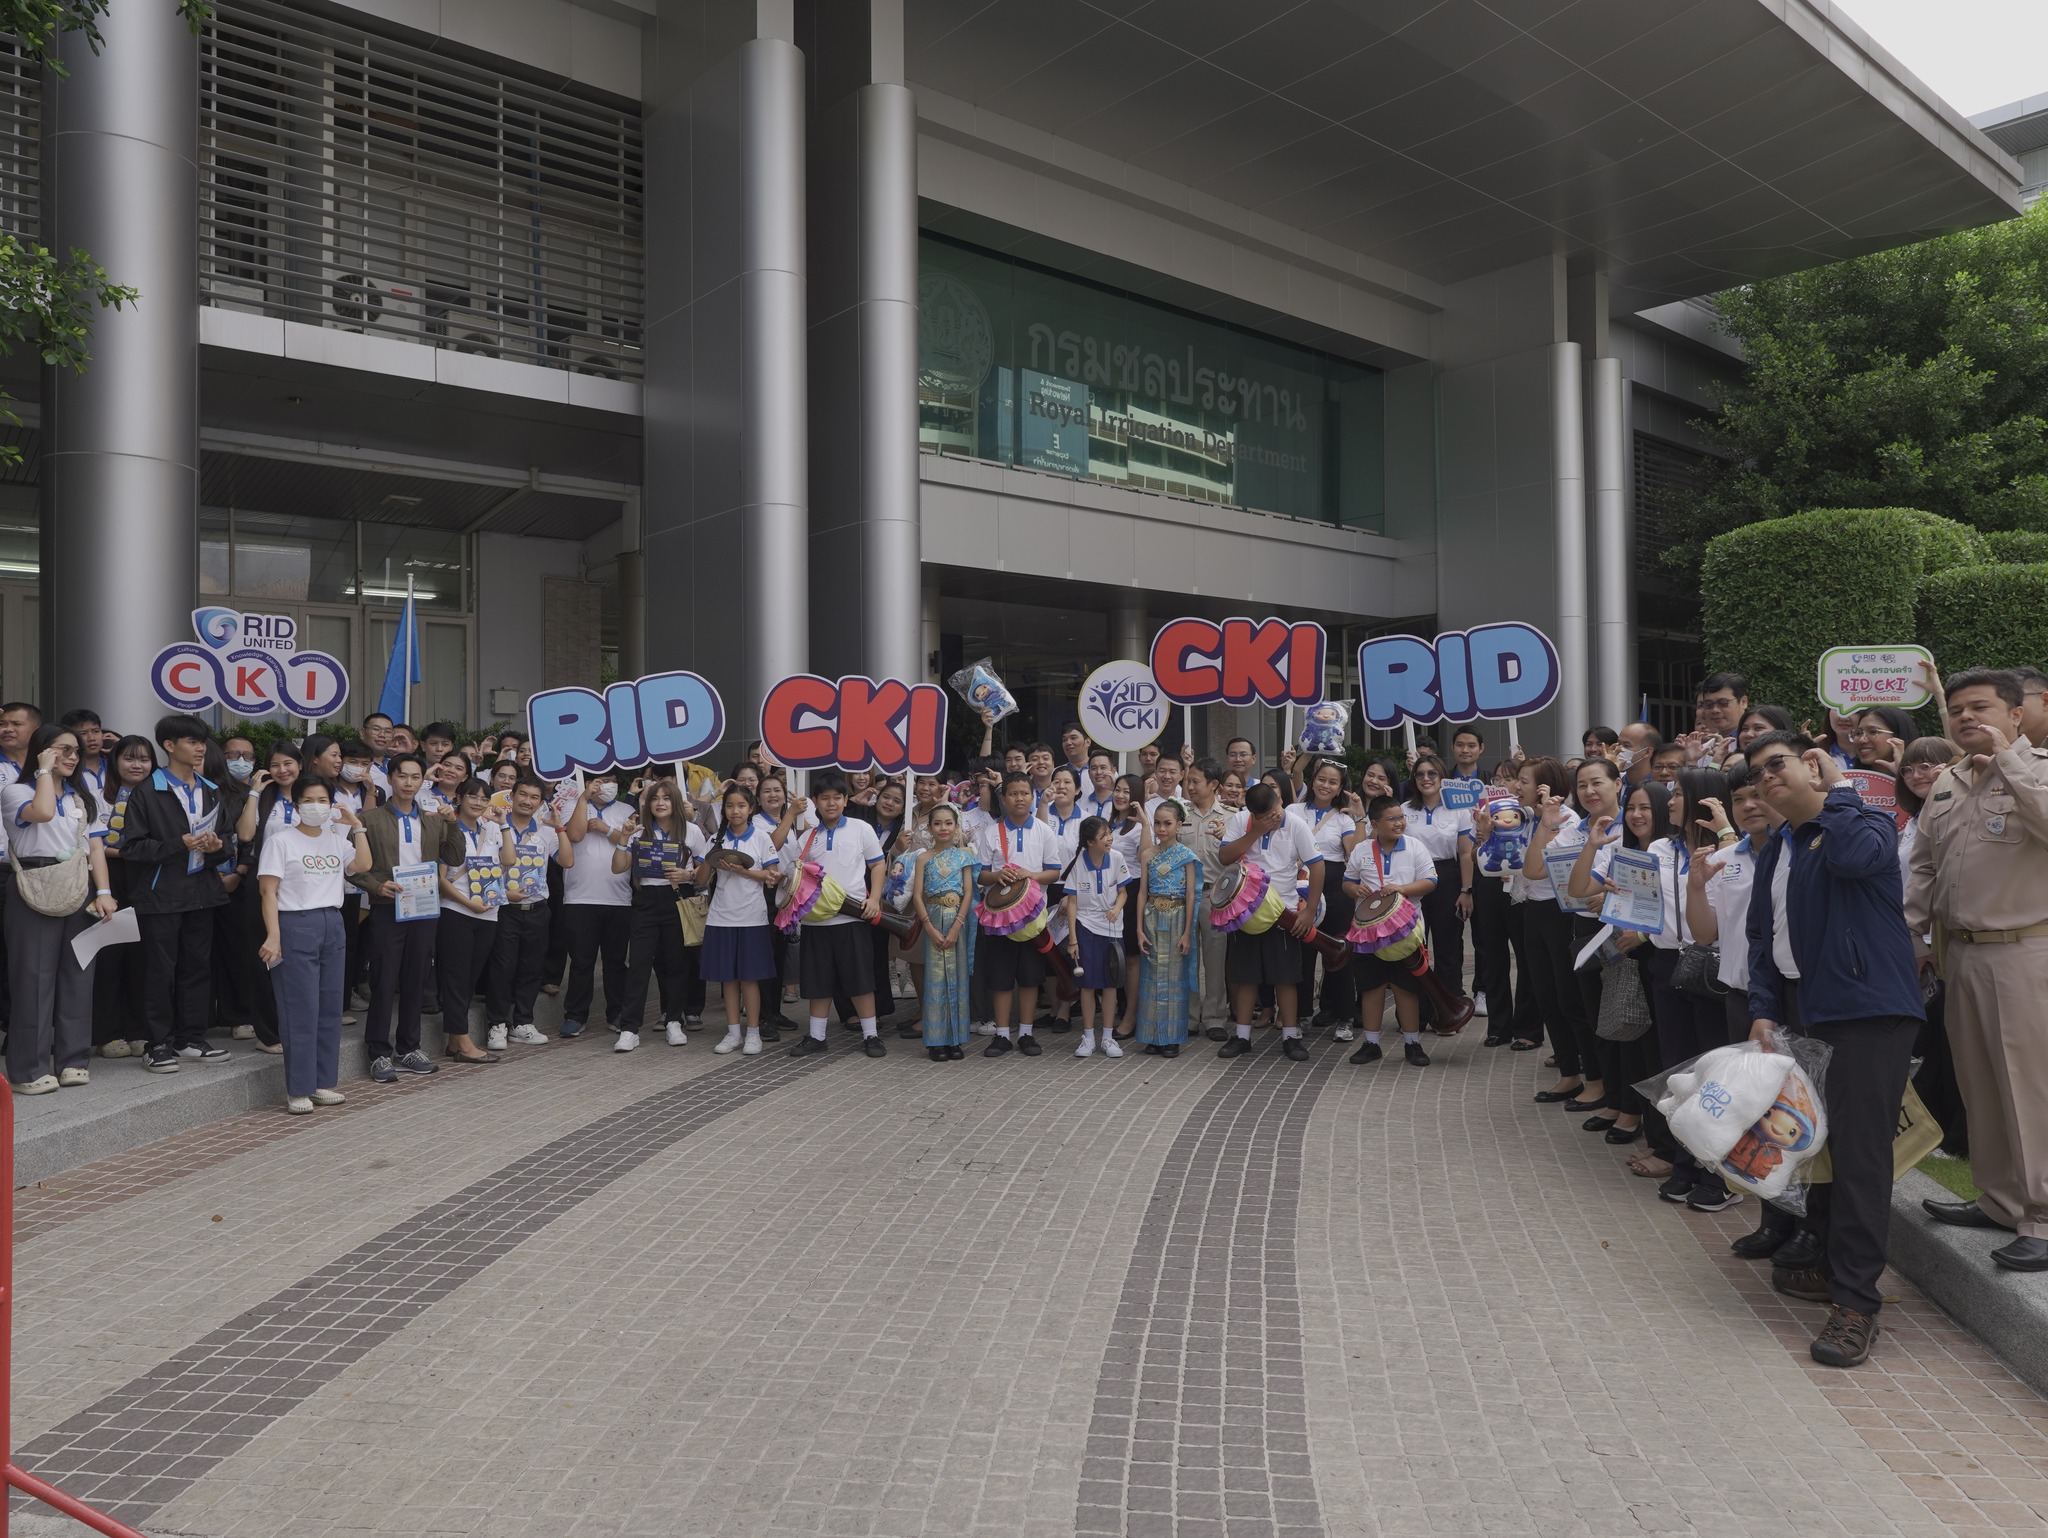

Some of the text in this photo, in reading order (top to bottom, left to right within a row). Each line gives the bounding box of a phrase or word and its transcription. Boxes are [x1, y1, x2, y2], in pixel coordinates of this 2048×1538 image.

[1028, 322, 1307, 433] กรมชลประทาน
[1029, 390, 1093, 428] Royal
[1100, 406, 1196, 451] Irrigation
[1203, 430, 1307, 474] Department
[243, 615, 294, 638] RID
[177, 646, 199, 654] Culture
[243, 638, 293, 650] UNITED
[230, 651, 284, 688] Knowledge Management
[299, 655, 330, 665] Innovation
[1152, 618, 1324, 706] CKI
[1361, 623, 1556, 727] RID
[1840, 677, 1907, 692] RID CKI
[1114, 682, 1157, 704] RID
[296, 706, 326, 715] Technology
[1118, 708, 1160, 730] CKI
[531, 674, 721, 776] RID
[763, 675, 944, 773] CKI
[1451, 793, 1474, 804] RID
[1702, 1097, 1726, 1119] CKI
